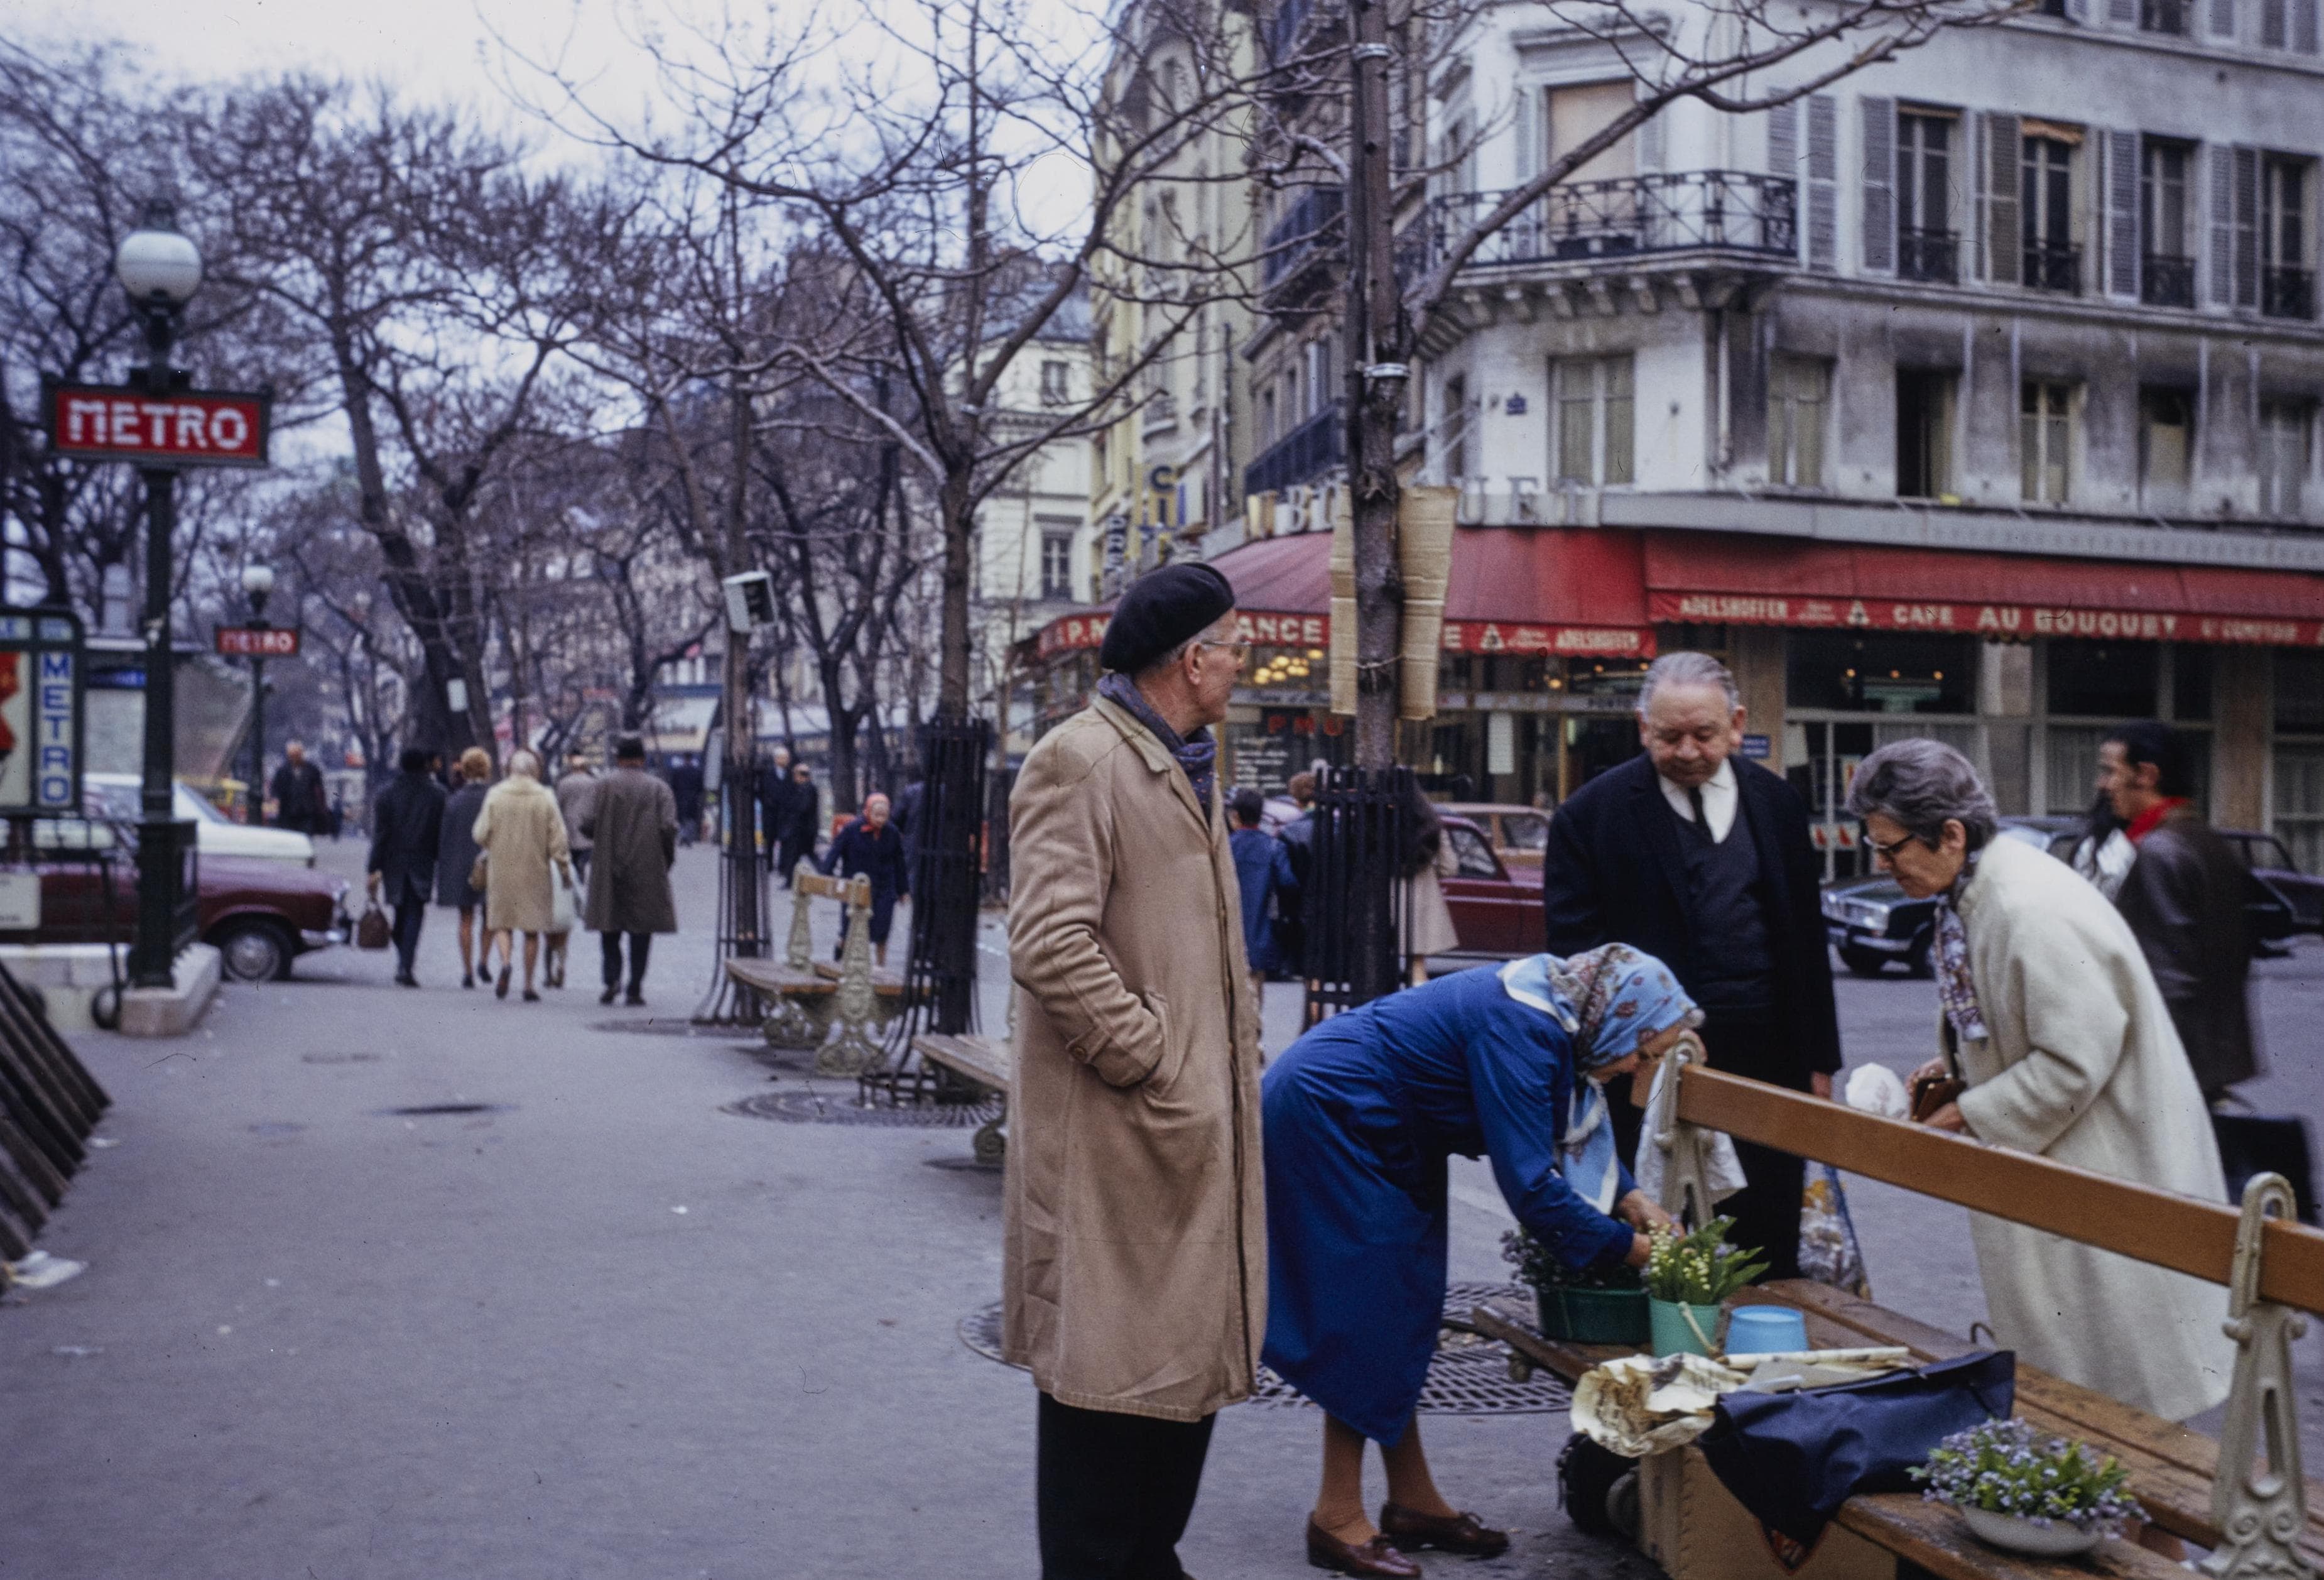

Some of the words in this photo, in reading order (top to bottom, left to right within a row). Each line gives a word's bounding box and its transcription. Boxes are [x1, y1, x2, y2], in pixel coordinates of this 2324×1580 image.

[68, 399, 248, 450] METRO
[1979, 606, 2021, 629] AU
[2034, 608, 2177, 637] BOUQUET
[41, 653, 70, 802] METRO
